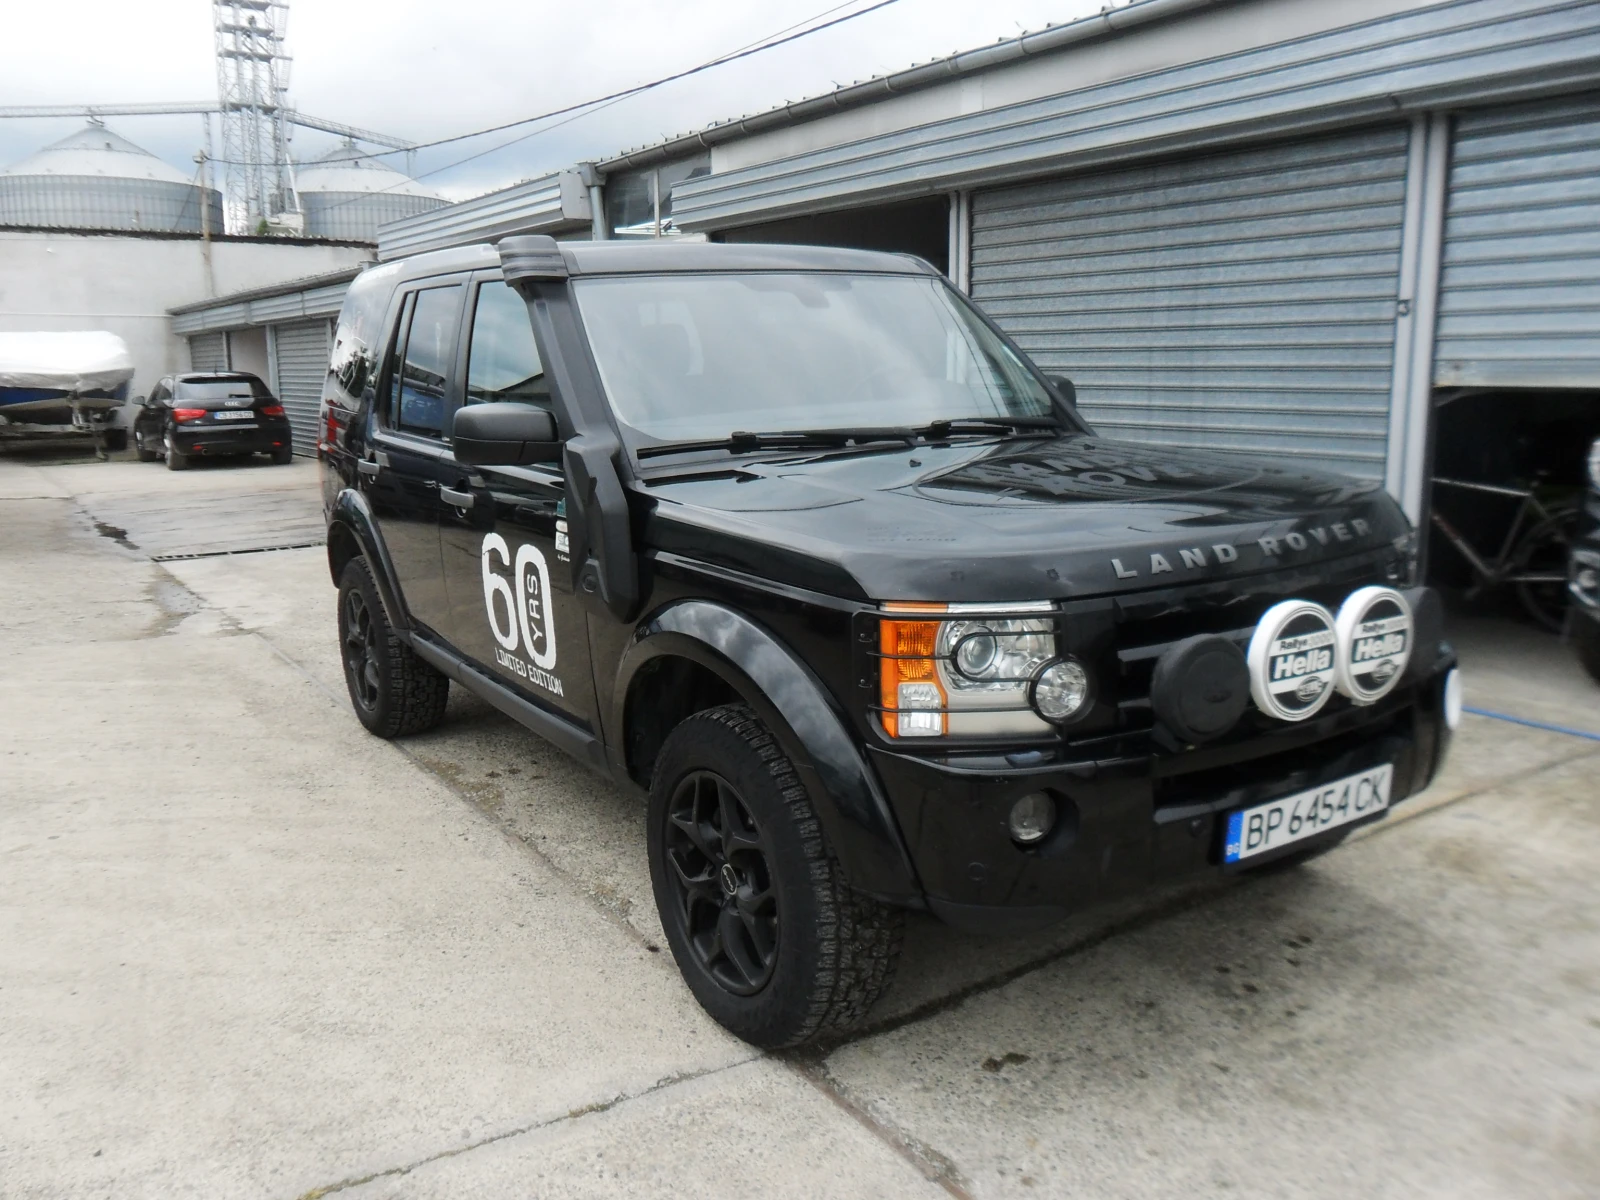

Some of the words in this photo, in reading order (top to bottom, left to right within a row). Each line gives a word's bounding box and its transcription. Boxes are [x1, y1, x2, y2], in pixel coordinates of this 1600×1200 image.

[966, 454, 1127, 483] LAND
[1111, 543, 1238, 579] LAND
[1257, 517, 1374, 557] ROVER
[482, 532, 556, 670] 60
[526, 573, 543, 641] YRS
[1274, 649, 1331, 679] Hella
[1280, 639, 1308, 651] Rallye
[1355, 634, 1404, 661] Hella
[495, 647, 527, 678] LIMITED
[528, 664, 564, 697] EDITION
[1246, 807, 1284, 850] BP
[1288, 784, 1350, 835] 6454
[1355, 771, 1386, 812] CK
